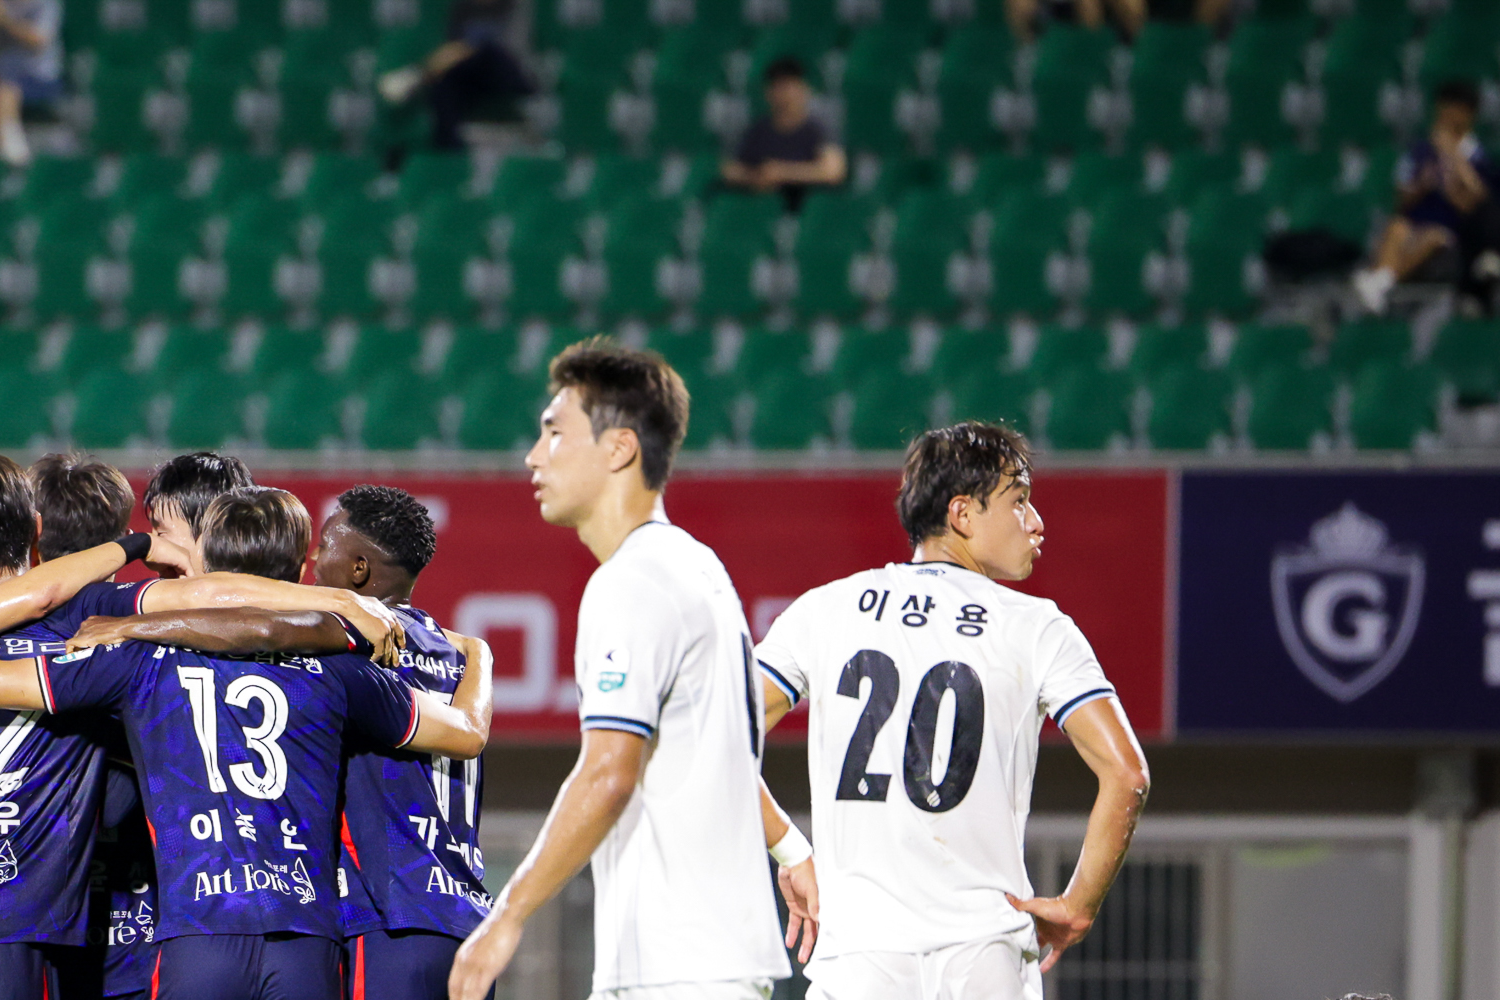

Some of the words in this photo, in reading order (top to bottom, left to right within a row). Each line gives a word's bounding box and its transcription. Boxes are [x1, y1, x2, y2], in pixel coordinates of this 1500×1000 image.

[858, 588, 988, 637] 이상용
[1301, 571, 1390, 664] G
[176, 665, 290, 801] 13
[835, 648, 986, 813] 20
[194, 868, 238, 902] Art
